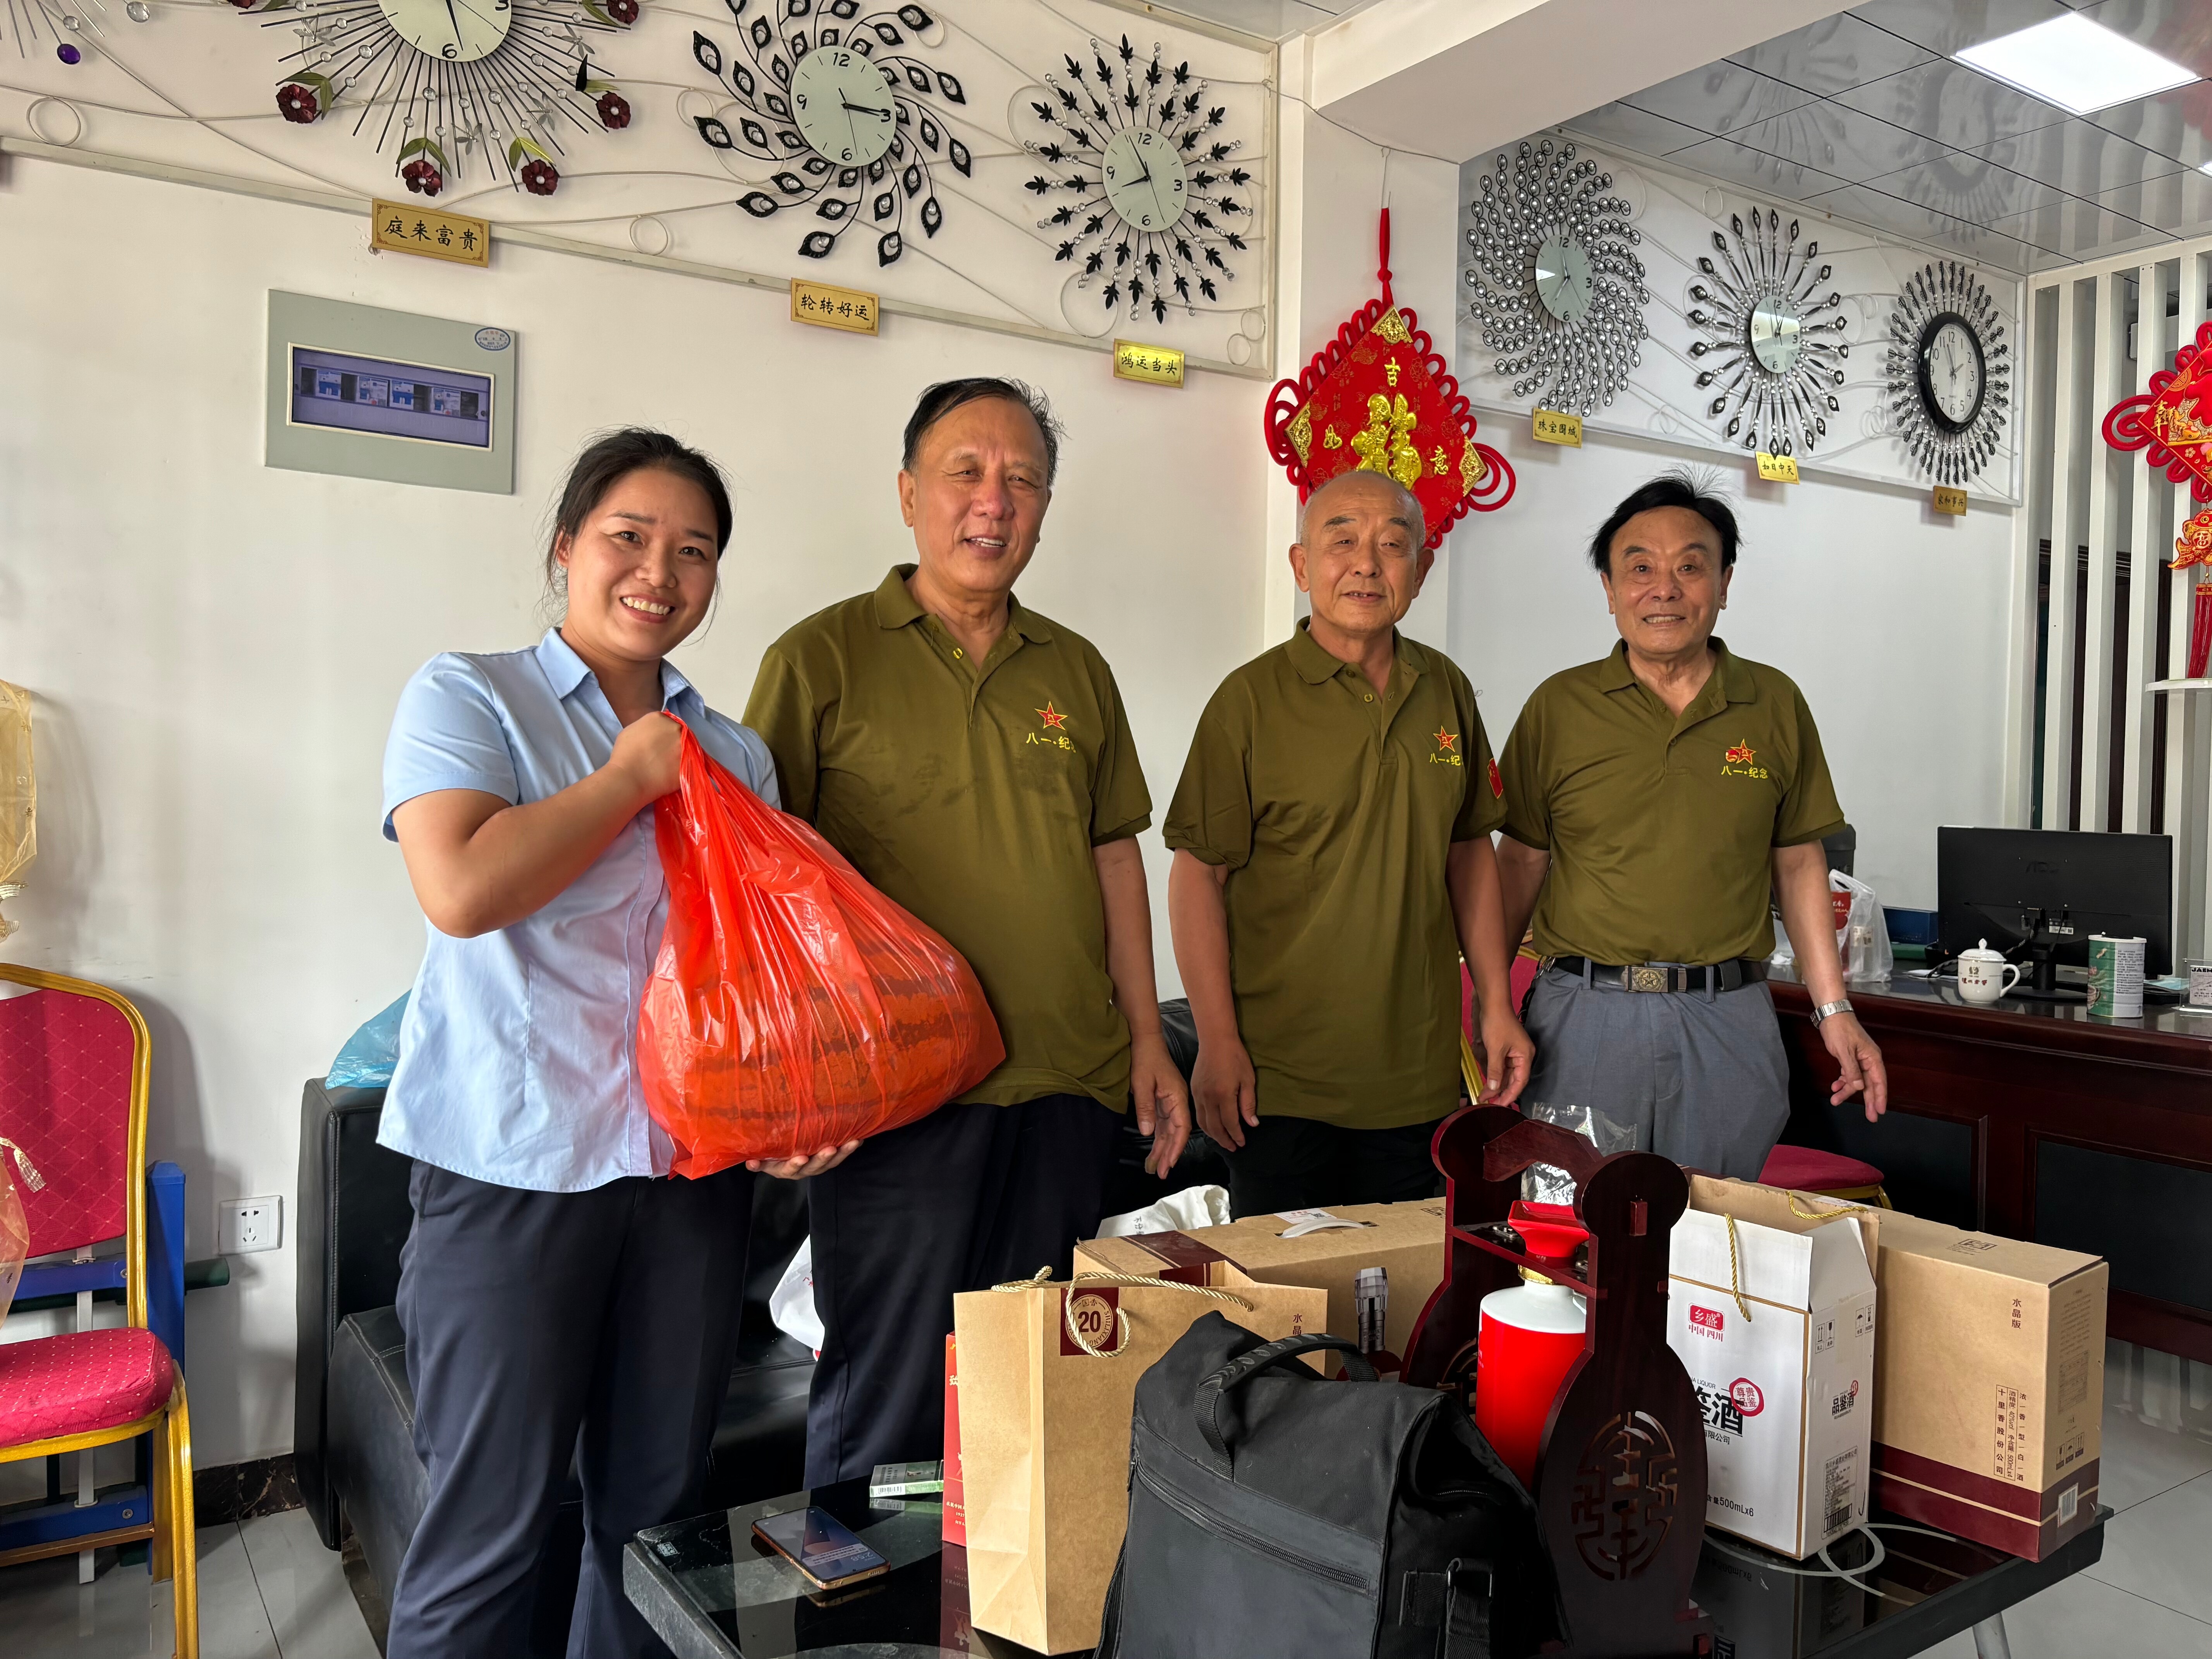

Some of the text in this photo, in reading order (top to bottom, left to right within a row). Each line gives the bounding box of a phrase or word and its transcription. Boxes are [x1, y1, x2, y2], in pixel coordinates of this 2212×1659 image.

[442, 43, 457, 59] 6
[833, 52, 850, 67] 12
[797, 94, 807, 110] 9
[881, 109, 891, 122] 3
[1138, 132, 1152, 145] 12
[841, 148, 852, 161] 6
[1107, 166, 1115, 179] 9
[1174, 179, 1182, 191] 3
[1142, 215, 1151, 226] 6
[385, 215, 477, 251] 庭来富贵
[1559, 237, 1569, 248] 12
[1586, 277, 1592, 289] 3
[801, 294, 869, 321] 轮转好运
[1774, 299, 1782, 309] 12
[1563, 311, 1570, 321] 6
[1754, 324, 1759, 335] 9
[1793, 335, 1798, 344] 3
[1939, 336, 1945, 348] 11
[1949, 331, 1955, 343] 12
[1932, 348, 1939, 360] 10
[1967, 352, 1972, 363] 2
[1122, 352, 1177, 376] 鸿运当头
[1772, 361, 1778, 369] 6
[1384, 357, 1401, 387] 吉
[1970, 371, 1975, 381] 3
[1967, 389, 1972, 400] 4
[1941, 397, 1945, 409] 7
[1960, 400, 1964, 412] 5
[1950, 404, 1955, 415] 6
[1693, 1309, 1717, 1328] 乡盛
[2012, 1298, 2022, 1329] 水晶版
[1078, 1311, 1101, 1333] 20
[1689, 1324, 1723, 1342] 中国 四川
[1697, 1379, 1716, 1389] LIQUOR
[1736, 1387, 1755, 1397] 尊贵
[1996, 1388, 2006, 1474] 十里香股份公司
